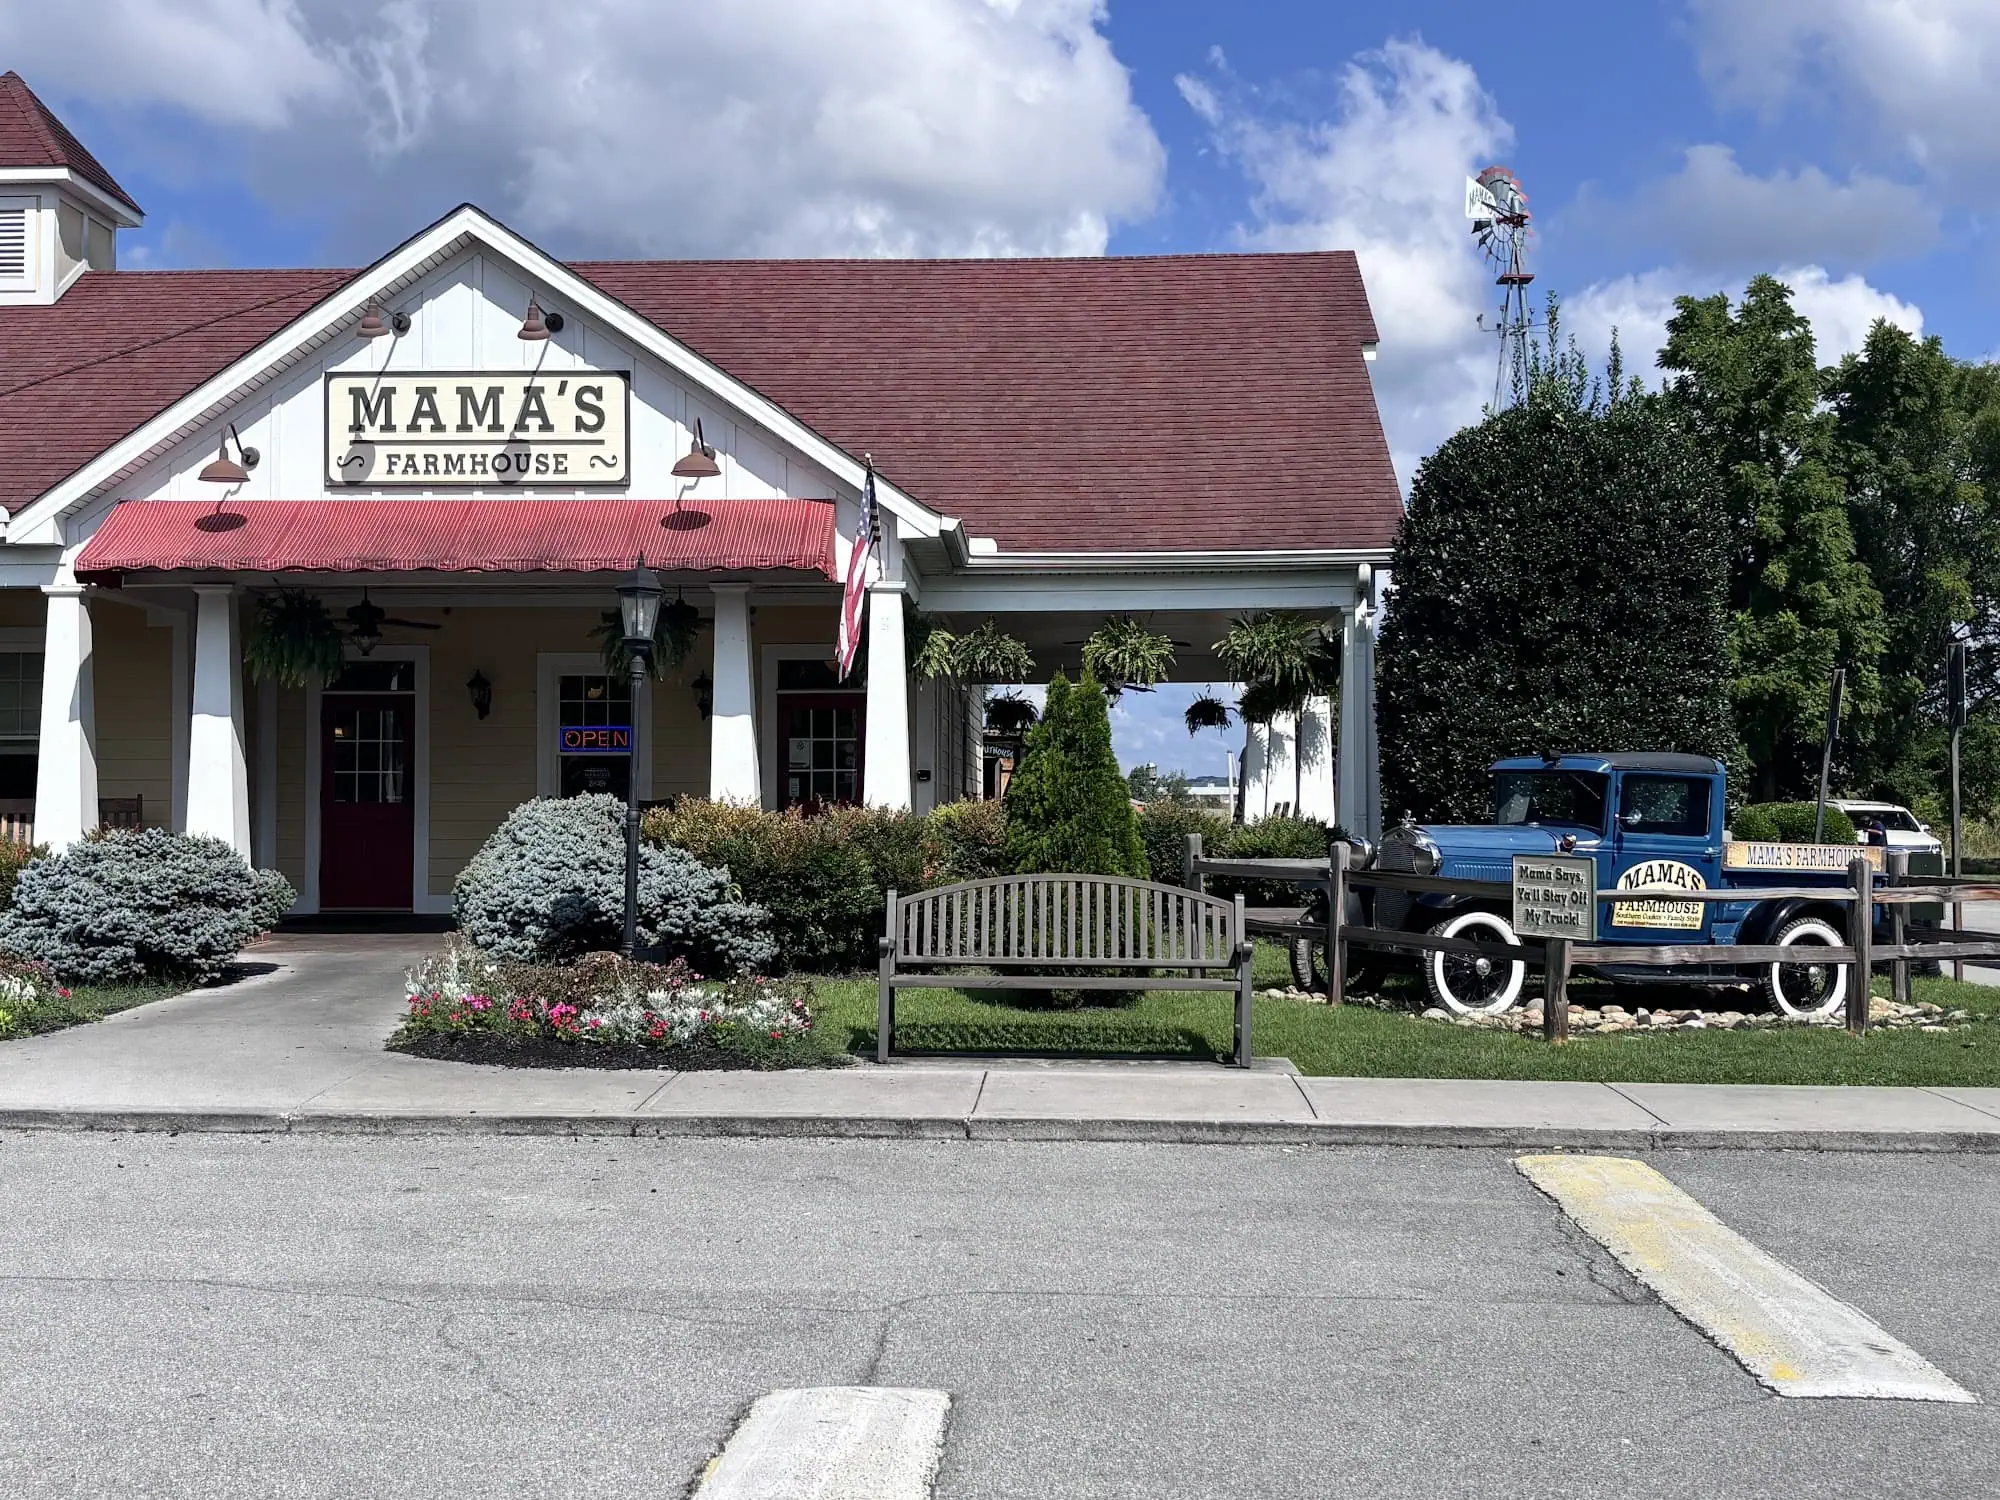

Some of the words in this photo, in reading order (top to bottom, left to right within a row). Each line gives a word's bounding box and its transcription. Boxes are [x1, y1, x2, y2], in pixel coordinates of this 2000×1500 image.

[348, 380, 606, 433] MAMA'S
[386, 453, 569, 475] FARMHOUSE
[565, 730, 628, 747] OPEN
[1747, 845, 1792, 866] MAMA'S
[1520, 865, 1553, 880] Mama
[1555, 868, 1584, 885] Says,
[1624, 863, 1701, 890] MAMA'S
[1543, 889, 1567, 907] Stay
[1571, 891, 1587, 905] Off
[1618, 899, 1700, 914] FARMHOUSE
[1525, 909, 1541, 925] My
